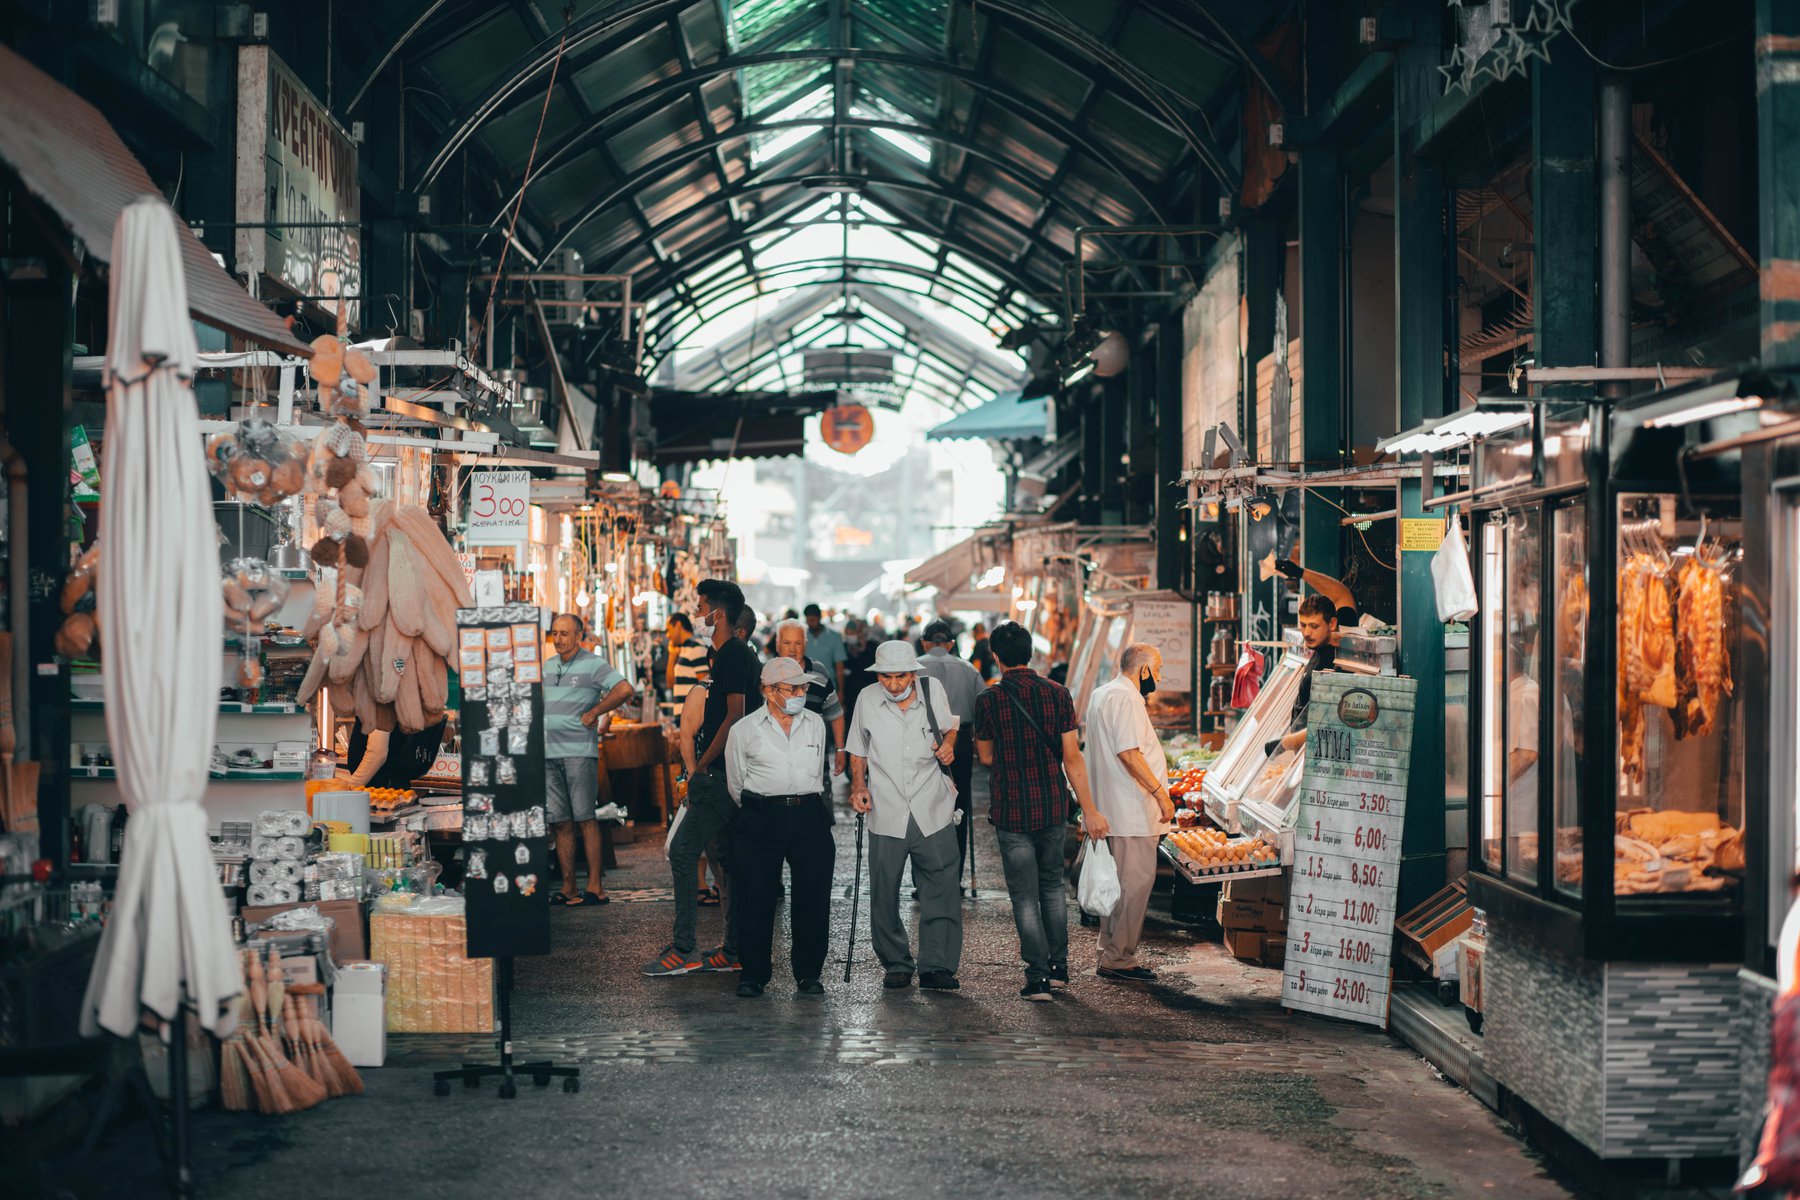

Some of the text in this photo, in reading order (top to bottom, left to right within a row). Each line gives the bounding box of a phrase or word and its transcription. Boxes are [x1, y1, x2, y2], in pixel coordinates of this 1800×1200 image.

[1314, 820, 1320, 841] 1
[1354, 826, 1387, 852] 6,00€
[1308, 856, 1323, 880] 1,5
[1352, 862, 1383, 888] 8,50€
[1306, 893, 1313, 914] 2
[1343, 898, 1379, 926] 11,00€
[1301, 932, 1310, 953] 3
[1339, 938, 1375, 965] 16,00€
[1299, 970, 1306, 992] 5
[1333, 977, 1371, 1004] 25,00€
